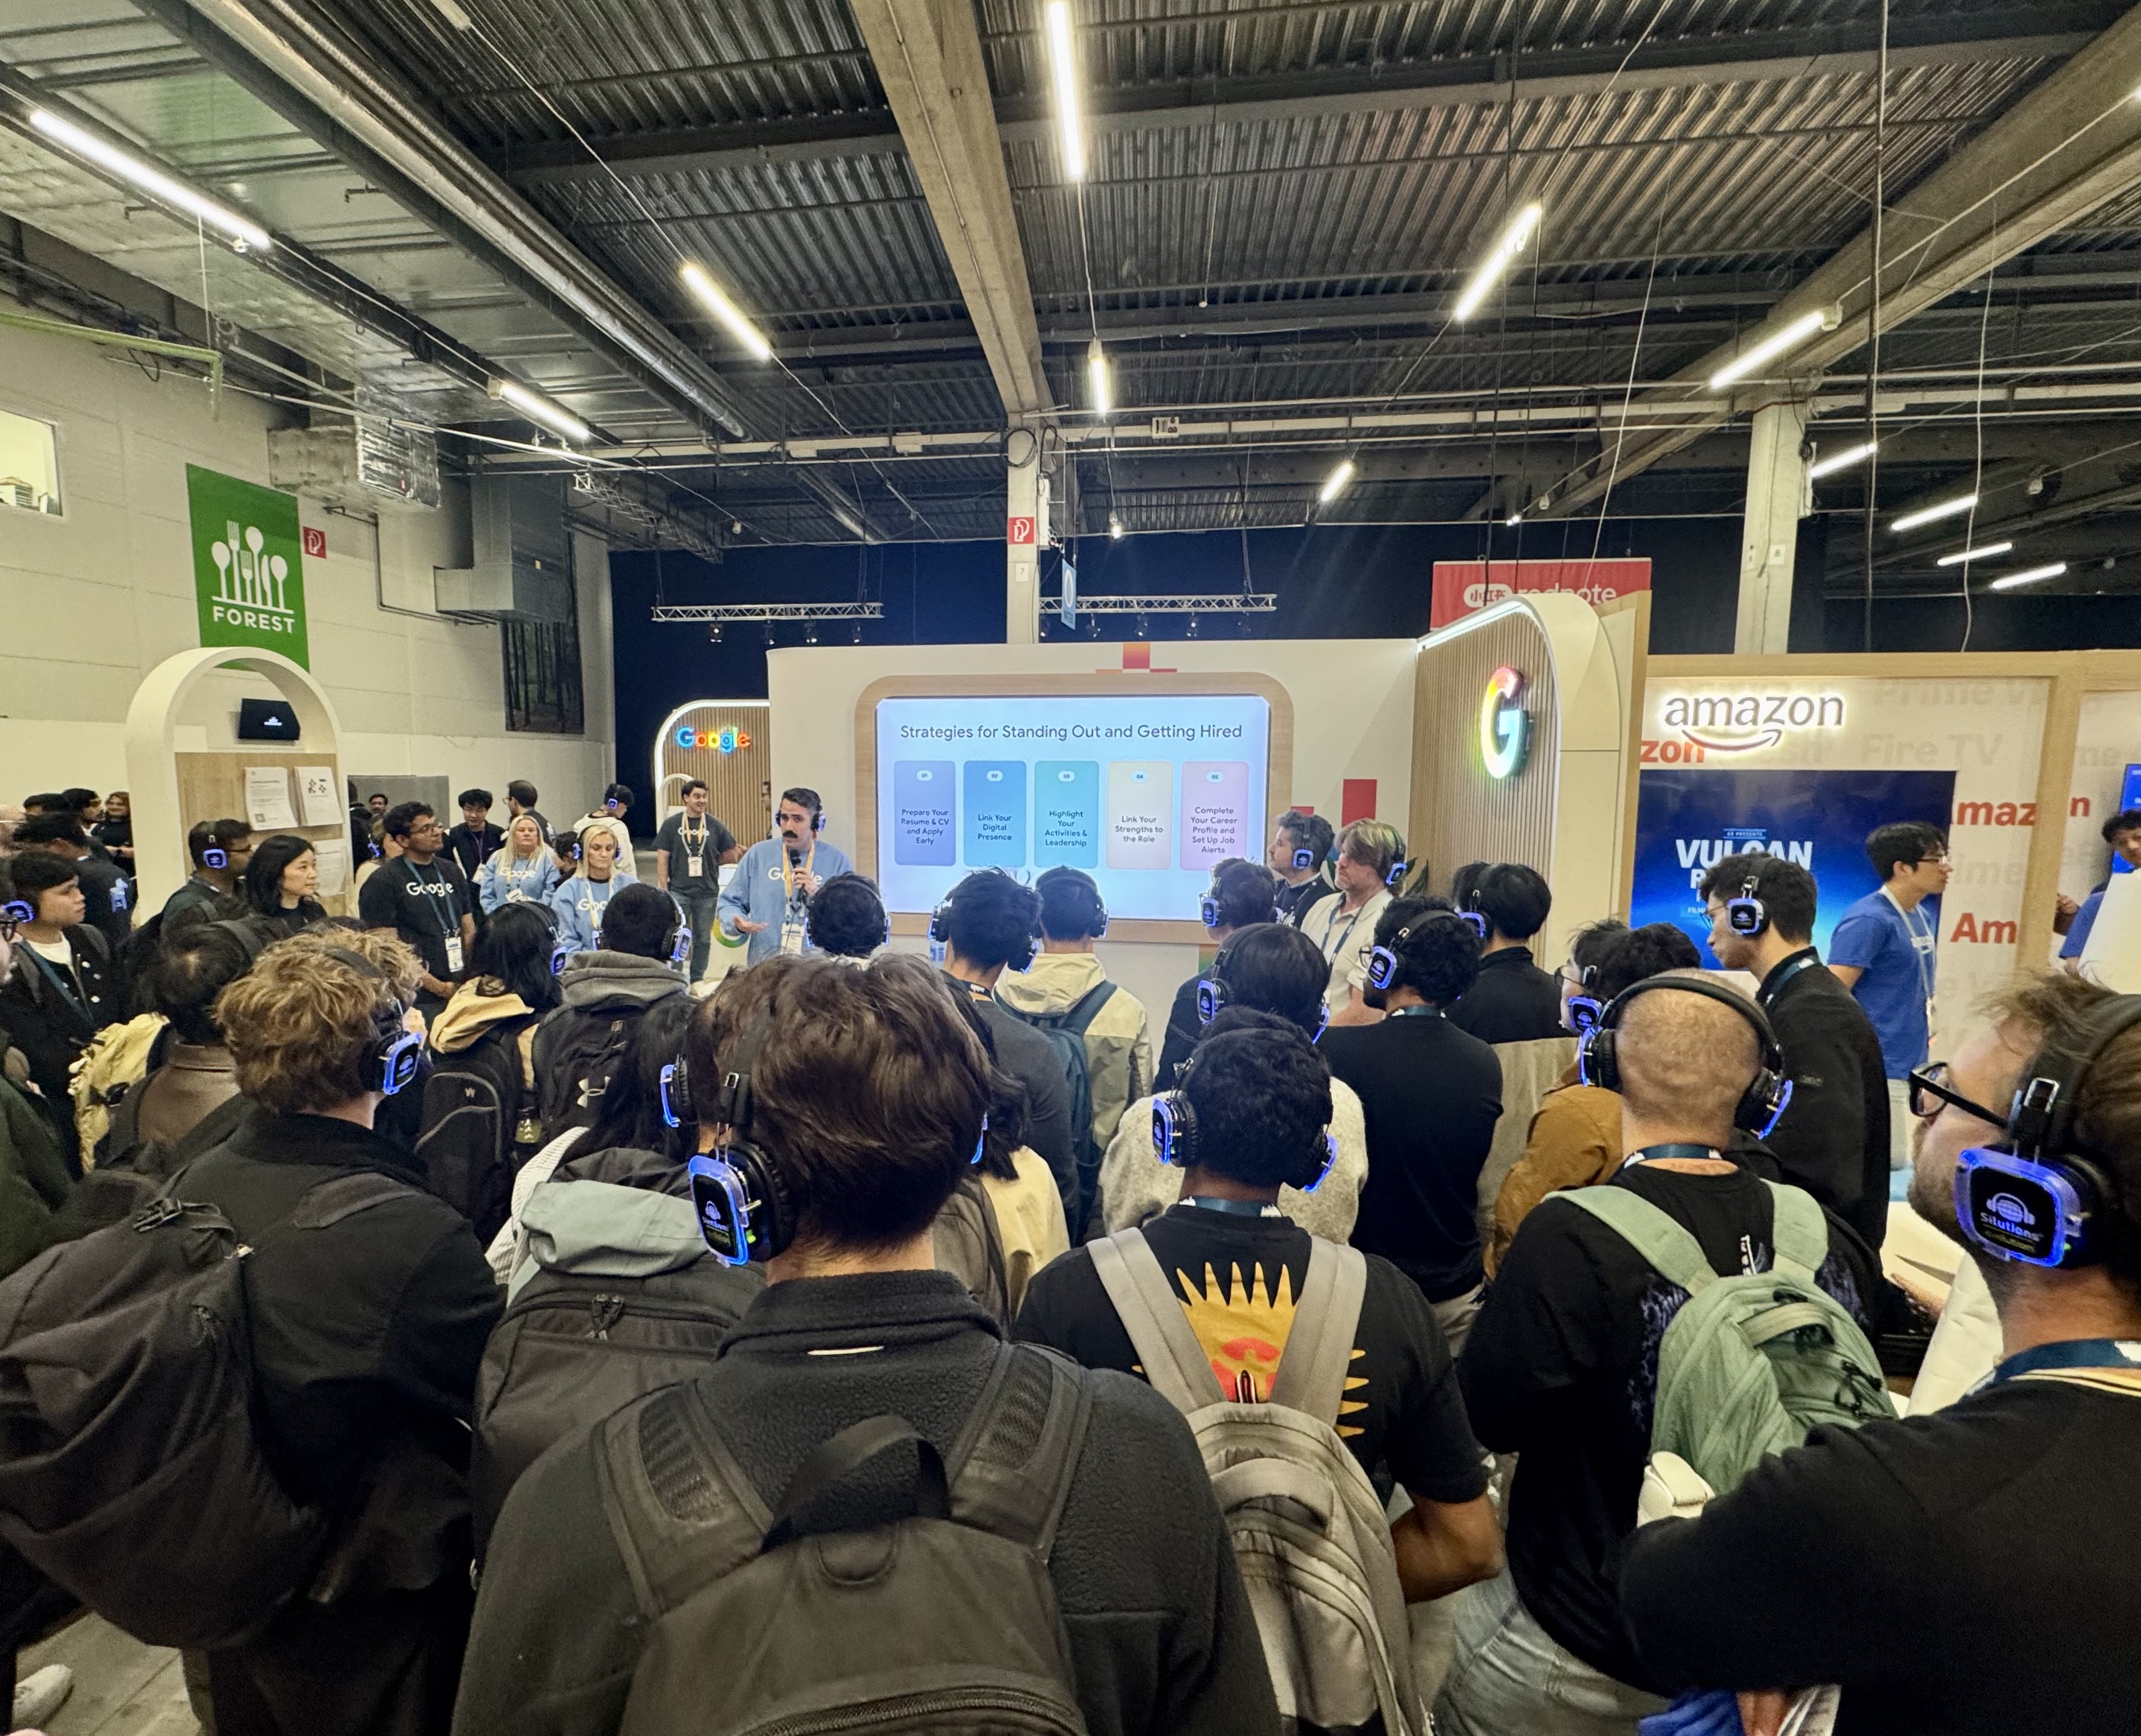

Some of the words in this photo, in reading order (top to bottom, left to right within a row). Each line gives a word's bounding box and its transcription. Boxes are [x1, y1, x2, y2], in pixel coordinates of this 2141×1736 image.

[213, 606, 295, 634] FOREST
[1664, 697, 1843, 726] amazon
[901, 725, 973, 741] Strategies
[978, 725, 998, 738] for
[1002, 725, 1067, 741] Standing
[1072, 724, 1100, 738] Out
[1105, 725, 1132, 738] and
[1137, 724, 1195, 741] Getting
[1201, 724, 1242, 738] Hired
[676, 726, 751, 754] Google
[1641, 740, 1705, 763] zon
[1948, 733, 2003, 765] TV
[1049, 810, 1083, 819] Highlight
[1194, 806, 1234, 815] Complete
[922, 828, 943, 836] Apply
[983, 824, 1007, 833] Digital
[1115, 826, 1153, 834] Strengths
[1045, 839, 1086, 847] Leadership
[1207, 836, 1218, 844] Up
[499, 867, 536, 881] Googe
[406, 882, 454, 897] Googe
